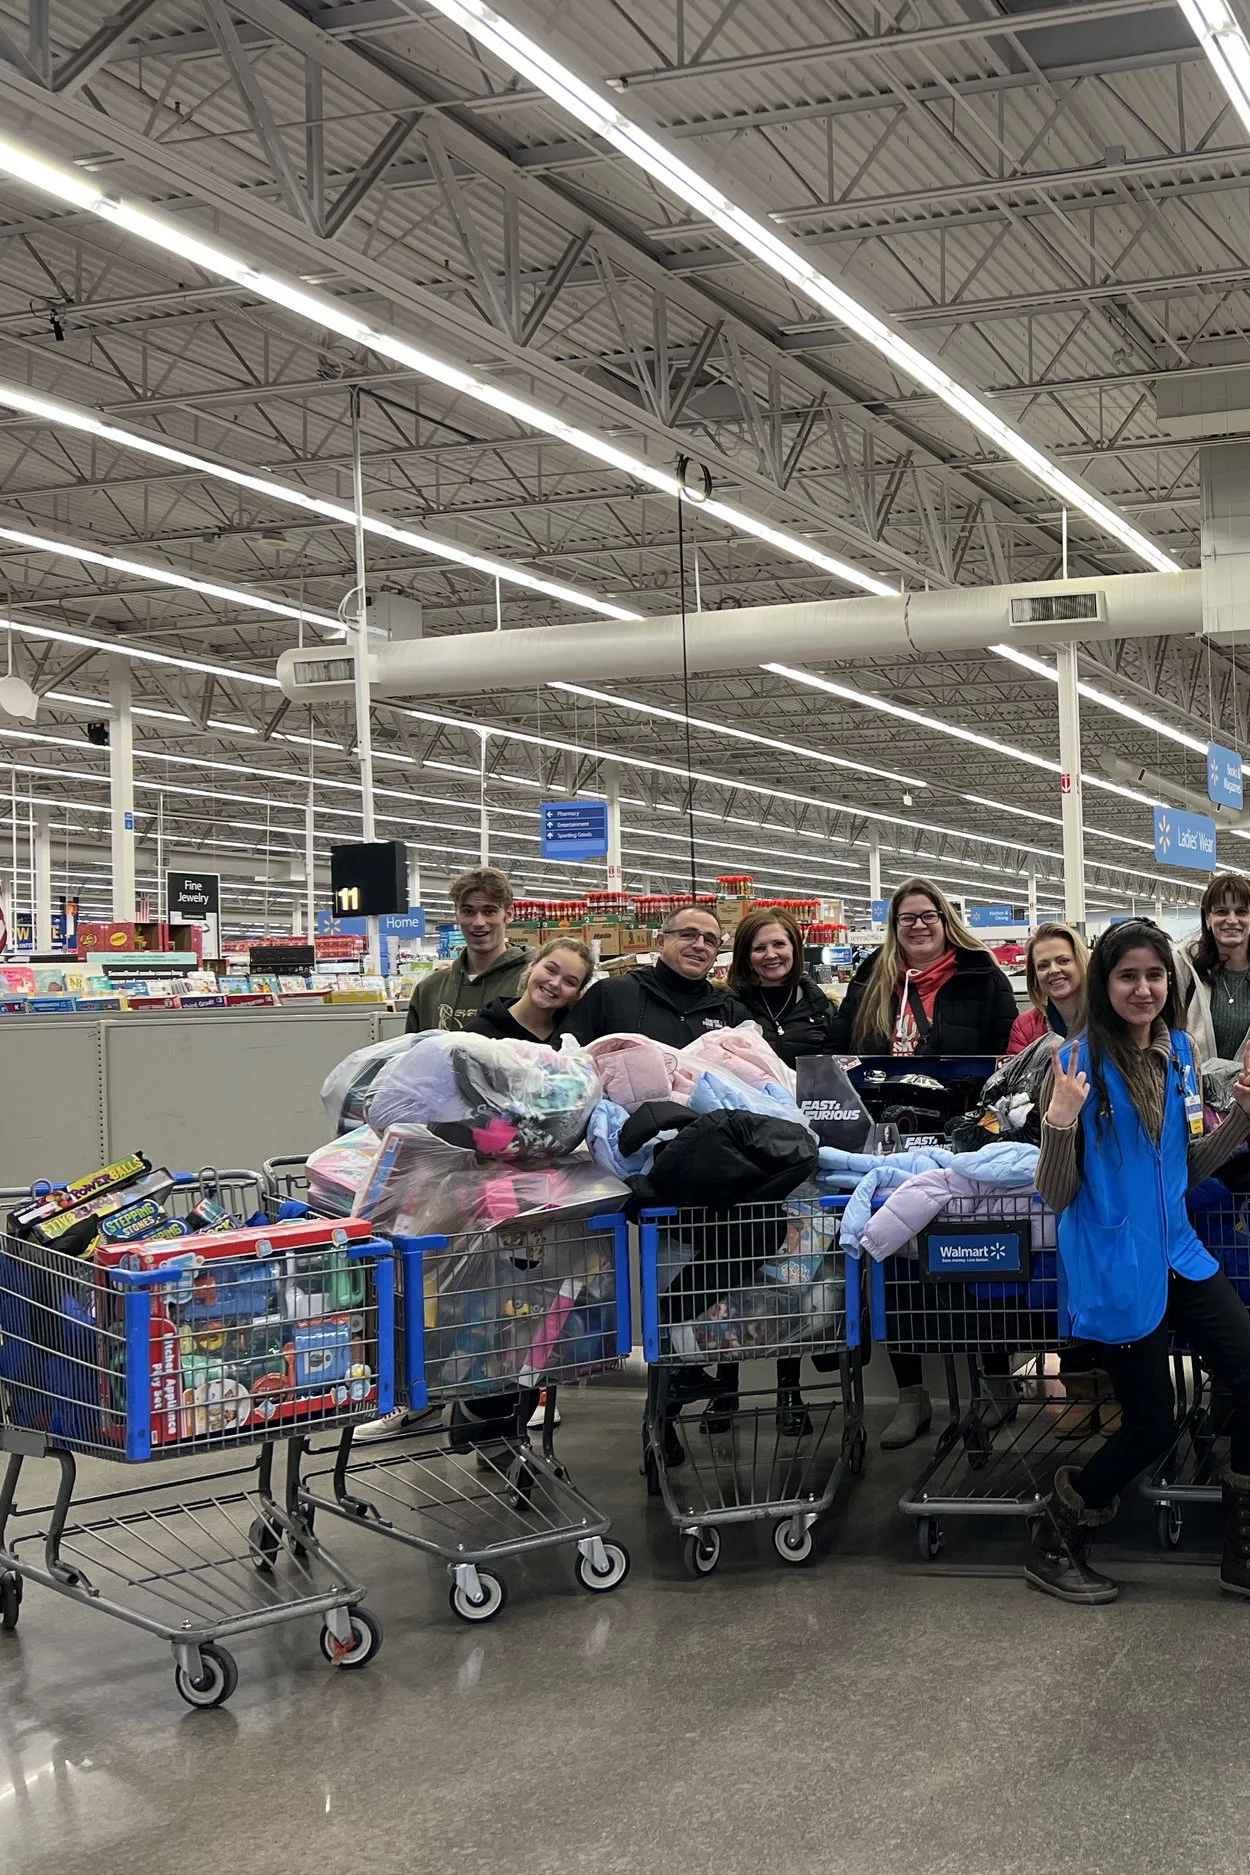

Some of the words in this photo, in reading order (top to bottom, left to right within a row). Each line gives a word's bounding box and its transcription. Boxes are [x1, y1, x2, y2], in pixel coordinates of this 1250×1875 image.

[1199, 832, 1213, 853] Wear
[184, 880, 203, 891] Fine
[177, 892, 209, 905] Jewelry
[338, 887, 359, 910] 11
[386, 917, 419, 928] Home
[803, 1110, 861, 1121] FURIOUS
[71, 1173, 113, 1199] POWER
[109, 1157, 143, 1180] BALLS
[41, 1212, 76, 1234] BALLS
[106, 1202, 155, 1233] STEPPING
[123, 1216, 155, 1236] STONES
[940, 1246, 988, 1257] Walmart
[153, 1389, 162, 1409] Set
[165, 1379, 178, 1434] Applince
